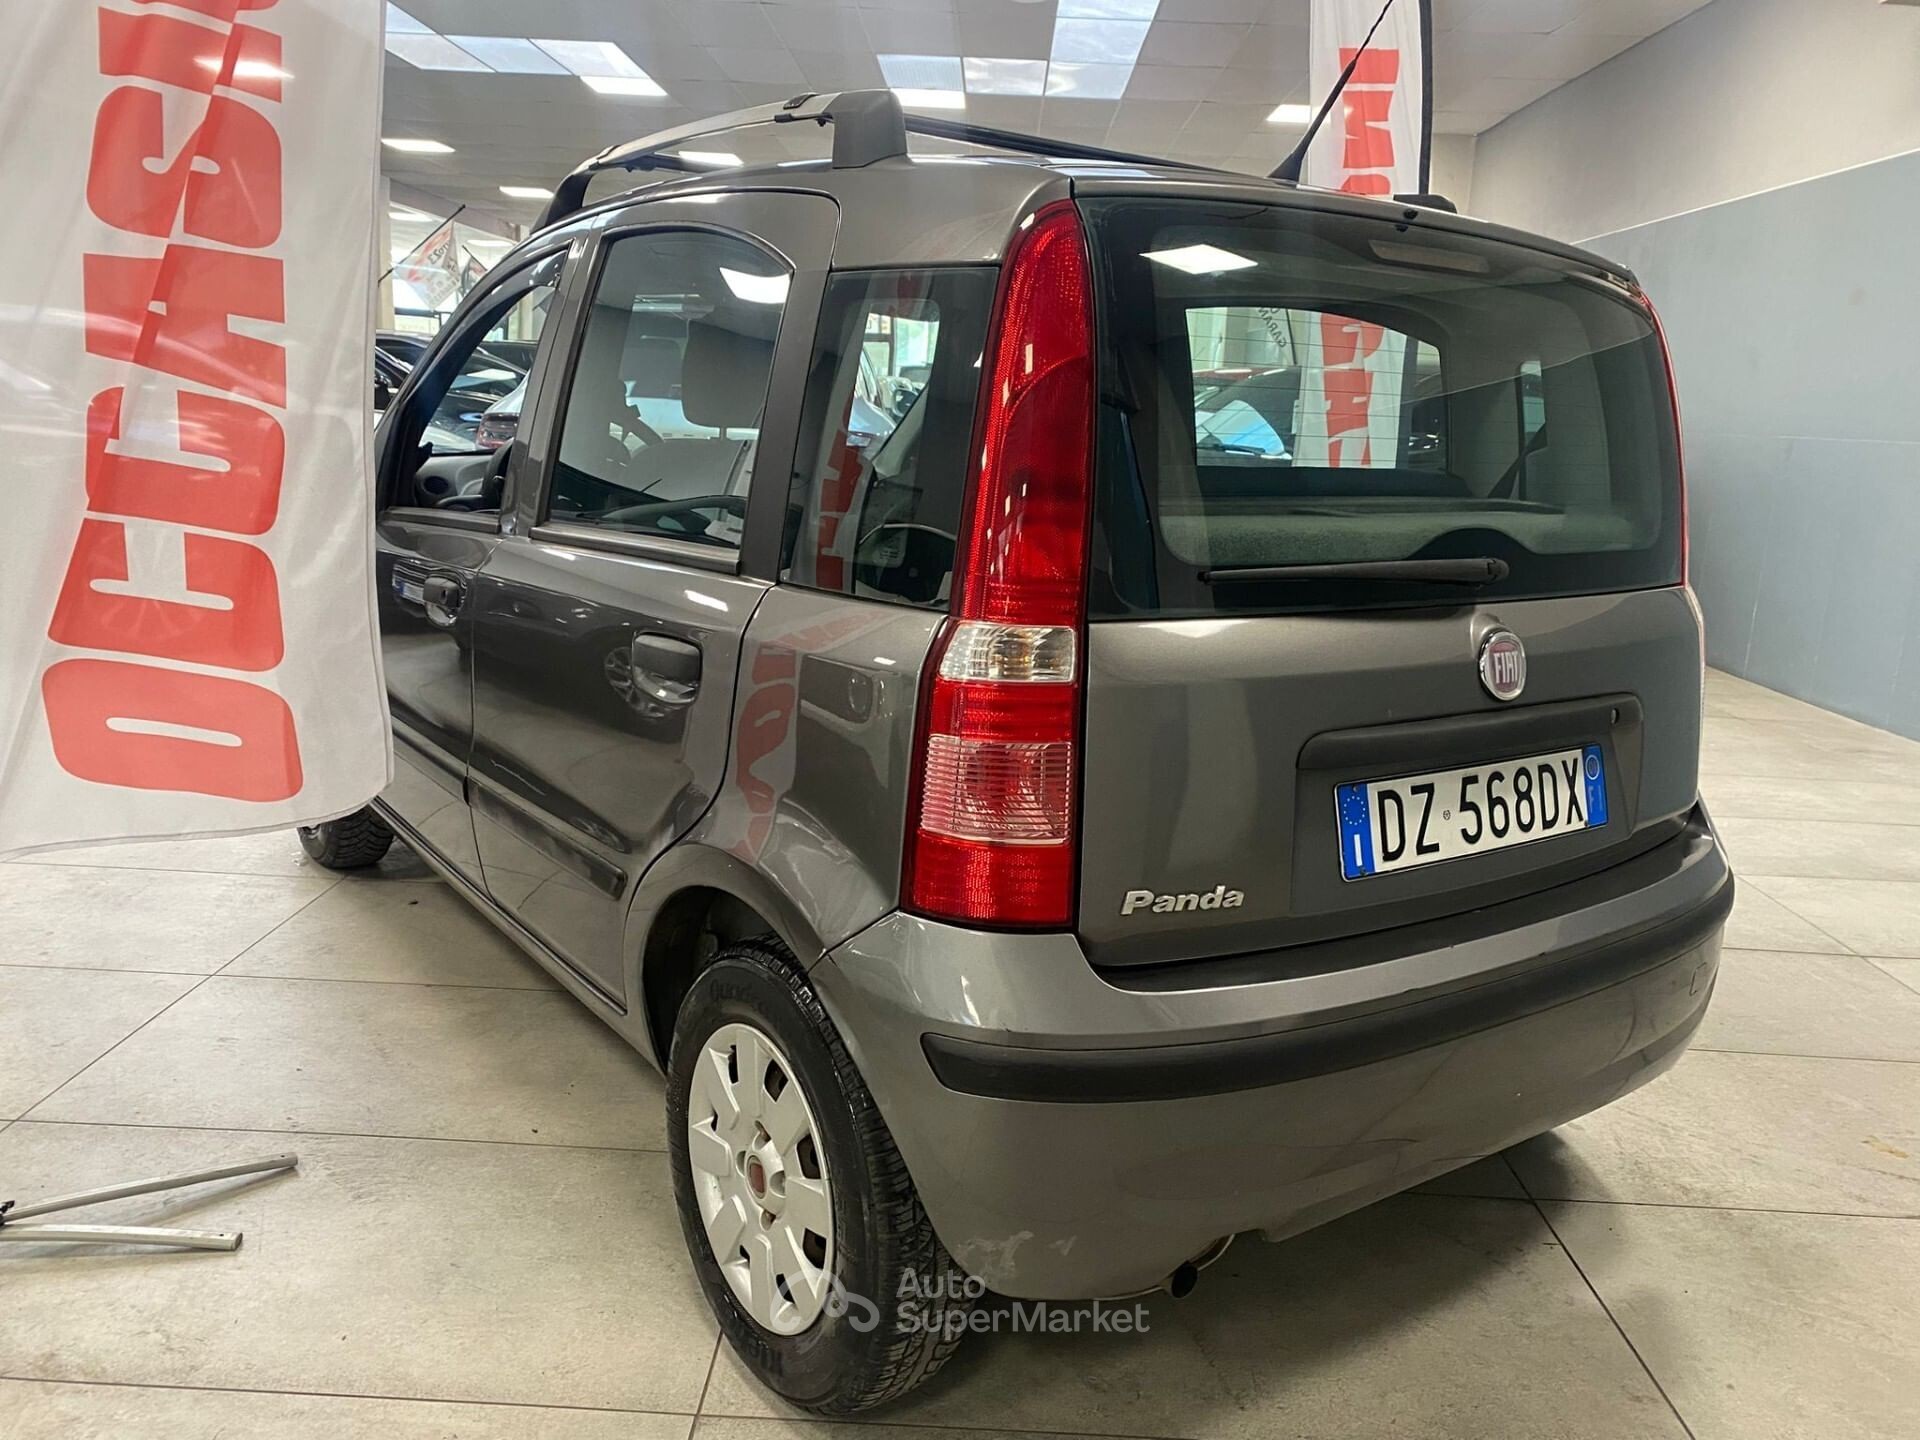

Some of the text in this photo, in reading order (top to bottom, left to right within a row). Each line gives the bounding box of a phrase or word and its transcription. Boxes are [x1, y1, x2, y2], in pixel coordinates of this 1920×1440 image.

[41, 0, 303, 803] OCCASI
[1493, 651, 1519, 684] FIAT
[1377, 781, 1440, 863] DZ
[1459, 757, 1584, 845] 568DX
[1120, 884, 1245, 915] Panda
